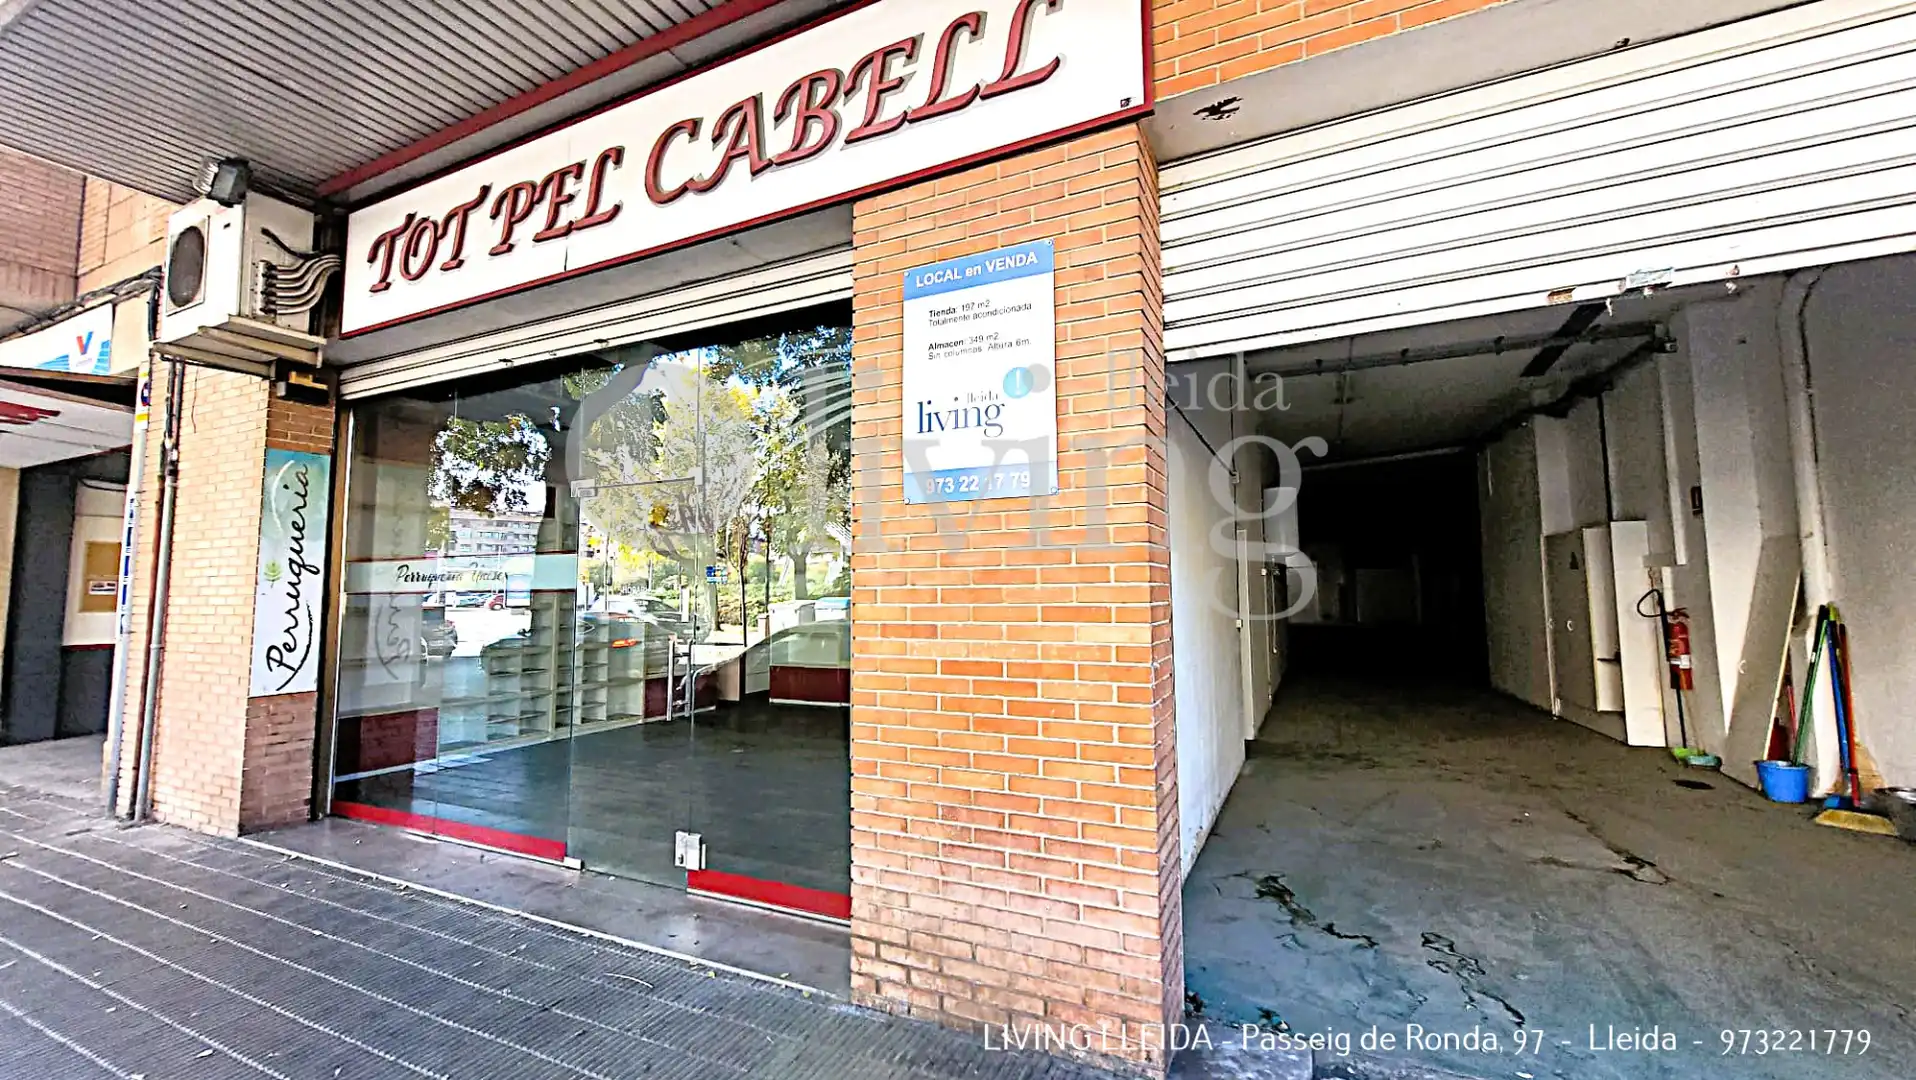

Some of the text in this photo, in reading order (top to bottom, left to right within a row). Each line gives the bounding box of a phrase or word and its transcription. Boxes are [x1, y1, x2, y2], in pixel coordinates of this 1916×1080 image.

[367, 0, 1063, 295] TOT PEL CABELL
[916, 251, 1039, 289] LOCAL en VENDA
[929, 302, 1032, 327] Totalmente acondicionada
[916, 397, 1006, 438] living
[926, 477, 954, 494] 973
[959, 475, 980, 492] 22
[1010, 471, 1031, 488] 79
[266, 462, 321, 674] Perruqueria
